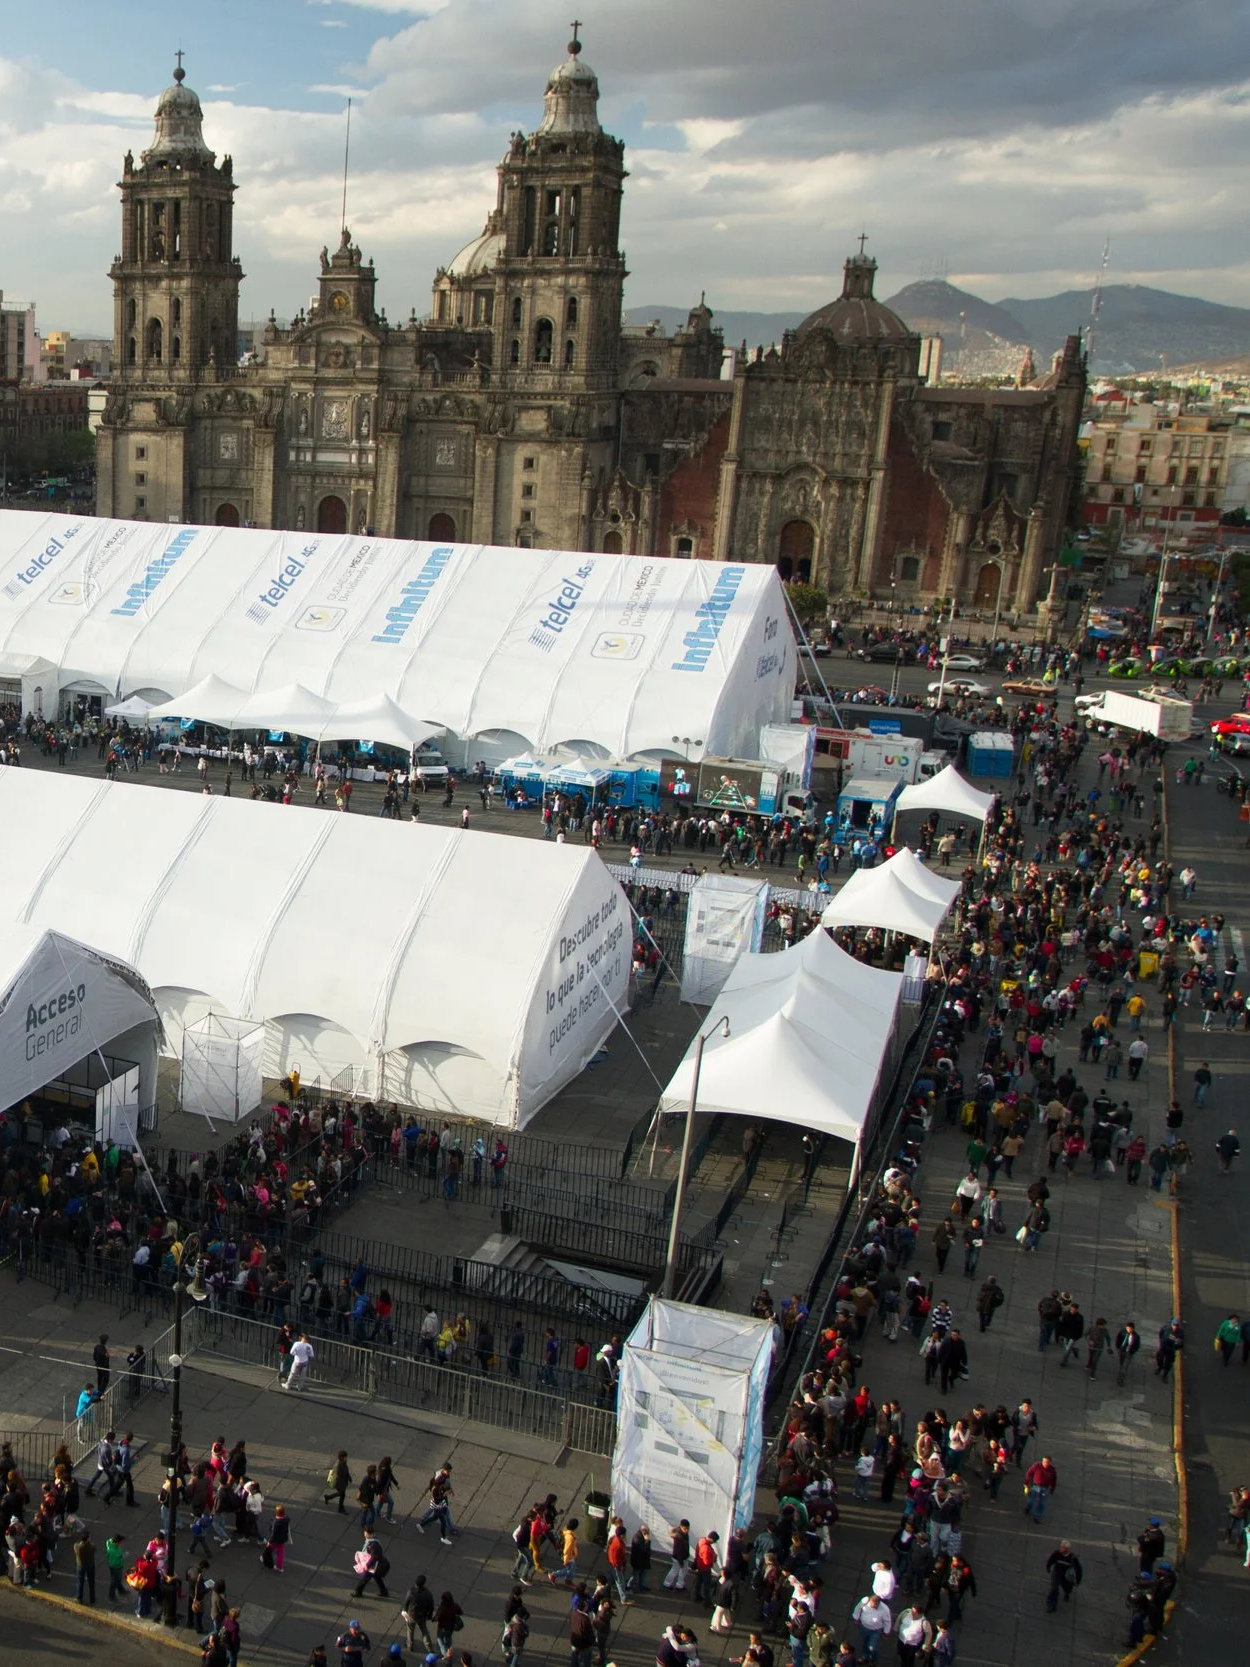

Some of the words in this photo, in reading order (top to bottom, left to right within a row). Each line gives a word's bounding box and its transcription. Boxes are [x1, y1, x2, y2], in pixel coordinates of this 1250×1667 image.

[17, 537, 65, 585] telcel
[110, 529, 200, 616] infinitum
[259, 556, 306, 608] telcel
[371, 547, 455, 644] infinitum
[540, 578, 583, 633] telcel
[618, 600, 639, 626] CIUDAD
[671, 566, 746, 672] infinitum
[559, 911, 600, 964] Descubre
[601, 890, 618, 923] todo
[546, 988, 555, 1015] lo
[558, 973, 575, 1006] que
[576, 961, 585, 985] la
[586, 918, 624, 975] tecnología
[25, 983, 86, 1033] Acceso
[25, 1010, 83, 1062] General
[549, 1003, 577, 1057] puede
[615, 952, 621, 978] ti
